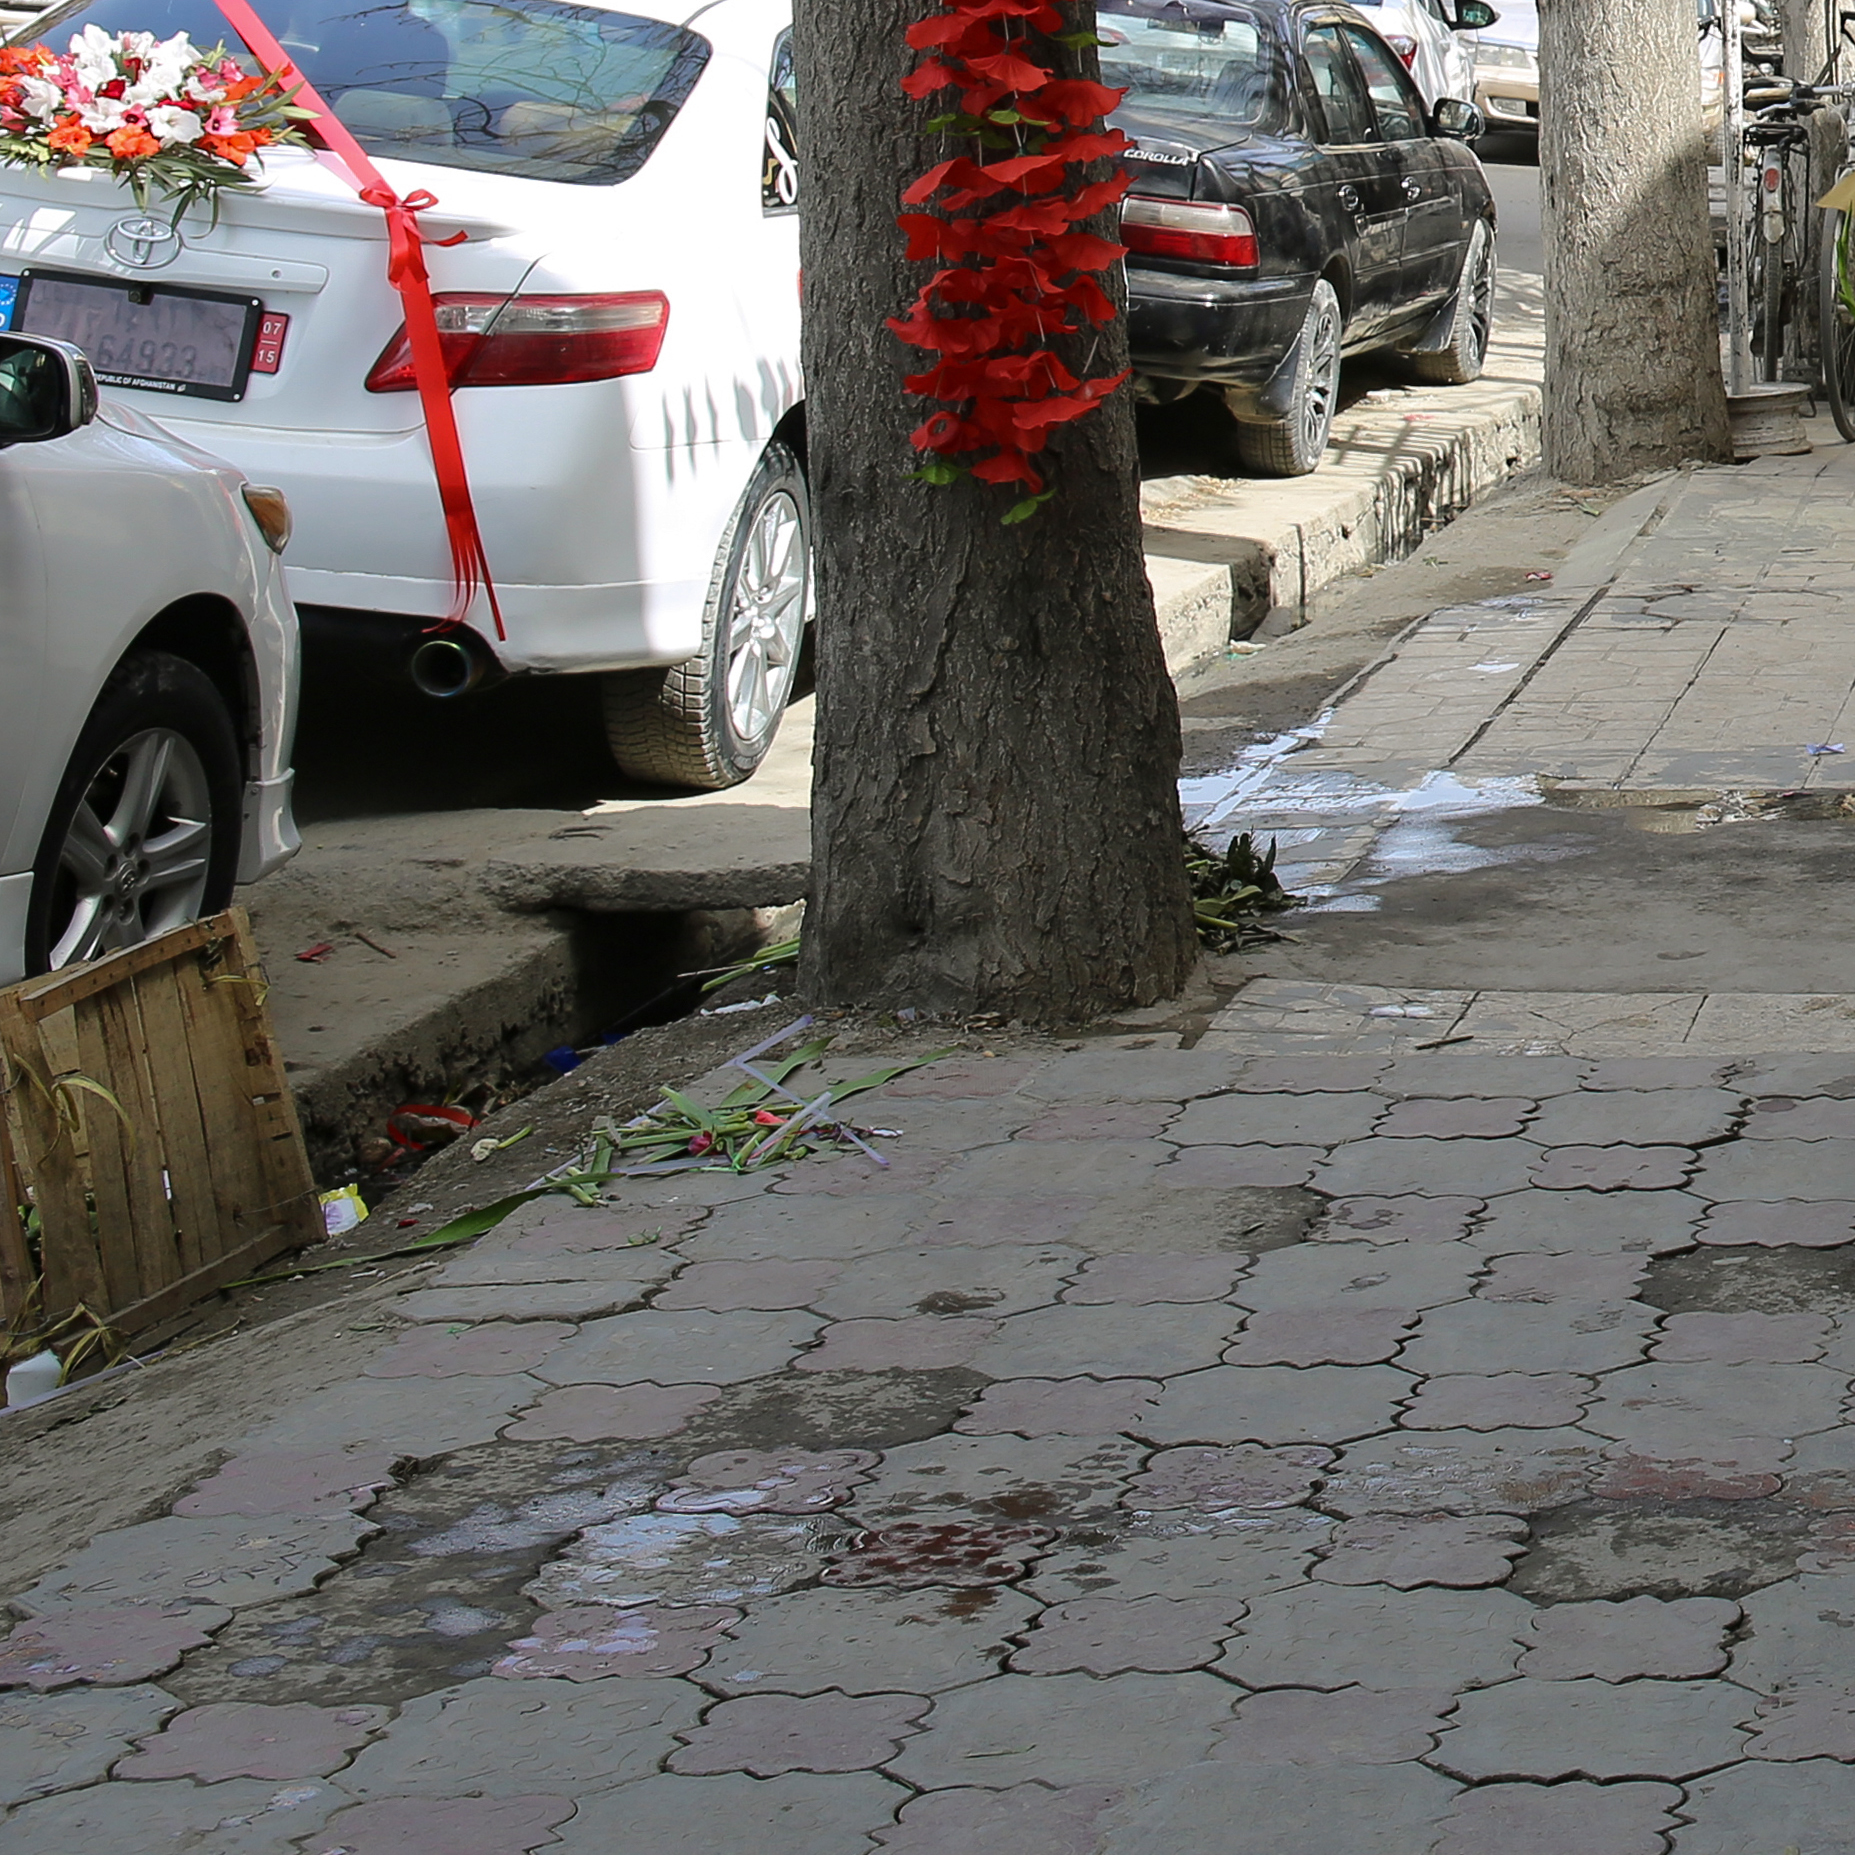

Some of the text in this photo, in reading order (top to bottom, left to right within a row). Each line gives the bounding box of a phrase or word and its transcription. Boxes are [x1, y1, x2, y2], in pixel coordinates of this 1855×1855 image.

[1123, 148, 1189, 166] COROLLA
[262, 321, 281, 336] 07
[257, 349, 275, 364] 15
[131, 378, 176, 391] AFGHANISTAN
